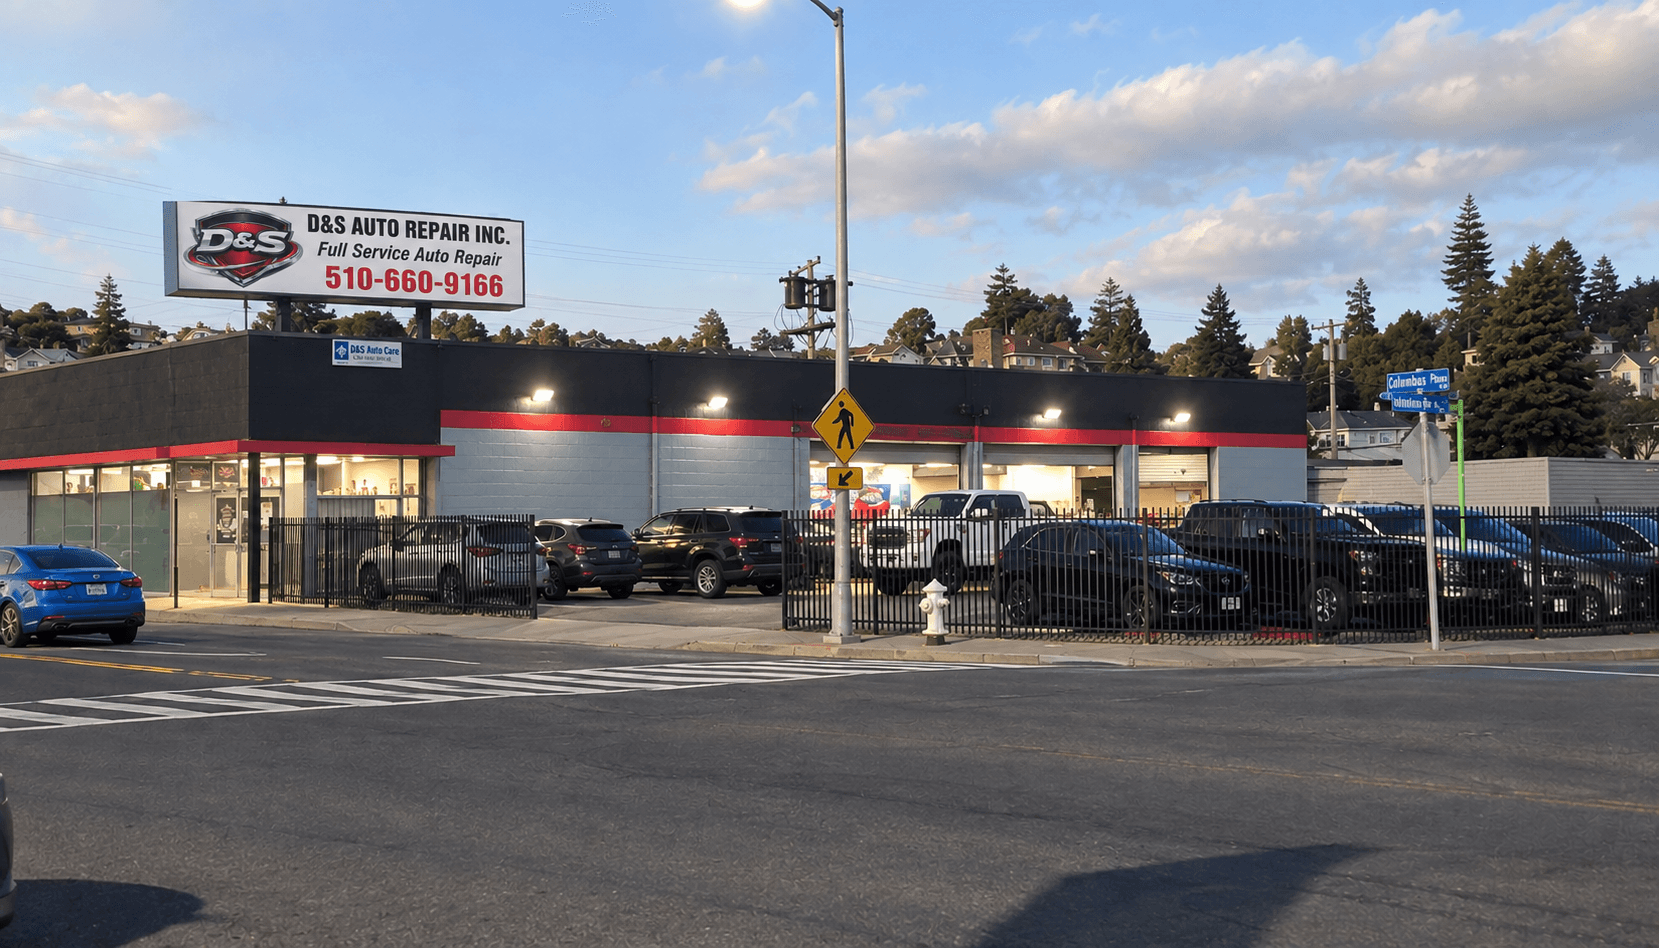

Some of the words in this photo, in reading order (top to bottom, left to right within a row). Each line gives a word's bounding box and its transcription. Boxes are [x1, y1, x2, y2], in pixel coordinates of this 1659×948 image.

[196, 228, 288, 254] D&S
[307, 213, 346, 236] D&S
[350, 216, 400, 240] AUTO
[405, 219, 470, 242] REPAIR
[475, 224, 511, 245] INC.
[317, 241, 348, 258] Full
[351, 243, 410, 261] Service
[413, 246, 450, 263] Auto
[453, 249, 503, 269] Repair
[325, 265, 503, 298] 510-660-9166
[366, 345, 383, 355] Auto
[383, 346, 400, 356] Care
